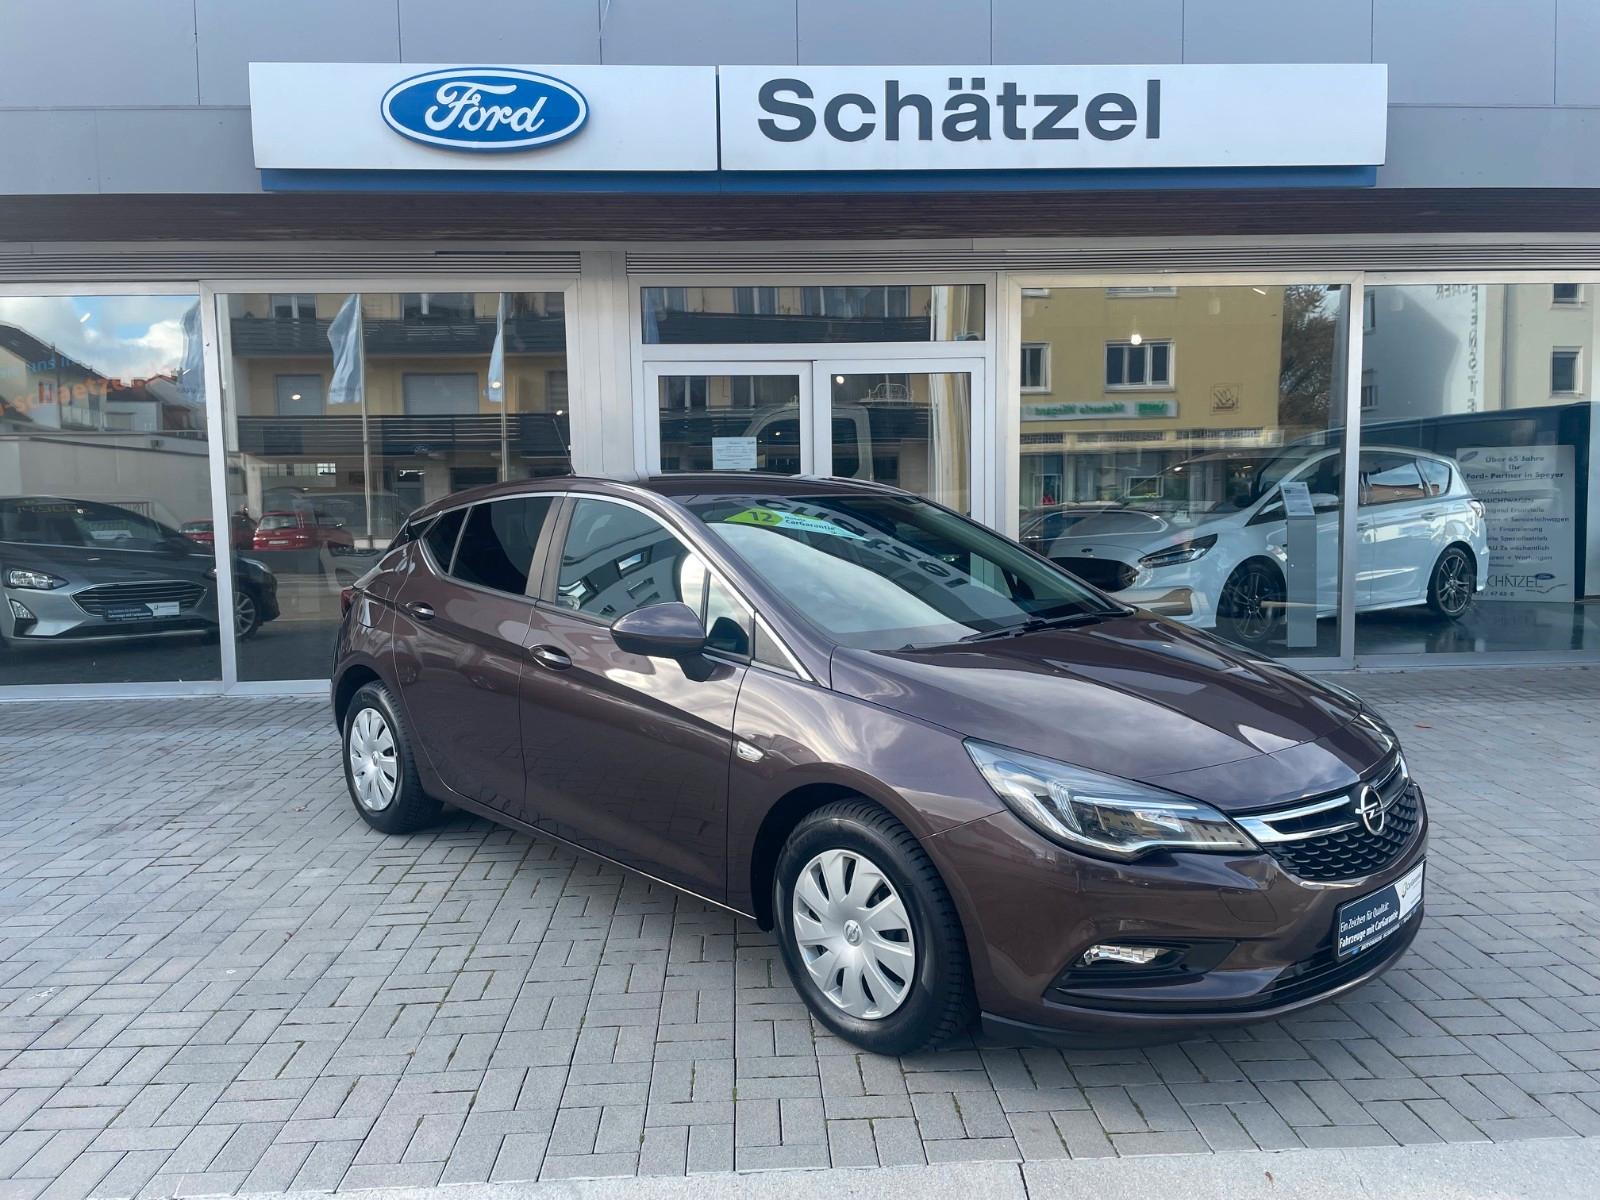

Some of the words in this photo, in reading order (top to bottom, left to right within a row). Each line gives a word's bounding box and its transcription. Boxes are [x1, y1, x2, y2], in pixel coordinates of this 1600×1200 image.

[424, 81, 548, 132] Ford
[757, 77, 1161, 142] Schätzel
[1535, 471, 1564, 480] Speyer
[747, 511, 775, 523] 12
[784, 519, 837, 531] CarGarantie
[1486, 573, 1544, 588] CHÄTZEL
[1340, 920, 1350, 932] Ein
[1348, 914, 1366, 929] Zeichen
[1339, 929, 1366, 949] Fahrzeuge
[1366, 925, 1375, 935] mit
